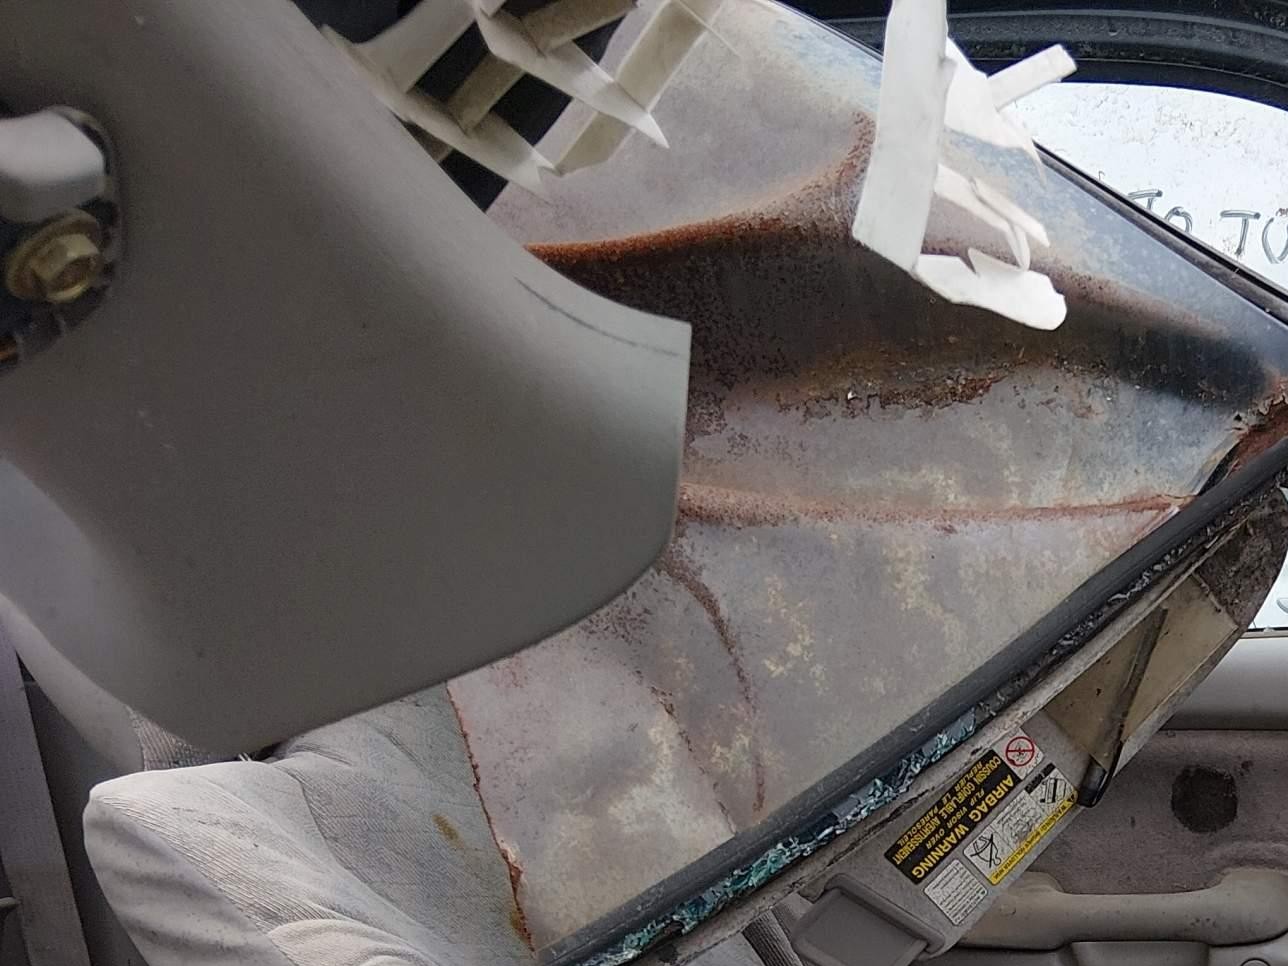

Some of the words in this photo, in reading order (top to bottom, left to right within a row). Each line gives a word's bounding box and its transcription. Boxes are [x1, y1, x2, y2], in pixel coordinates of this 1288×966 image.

[968, 774, 1014, 822] AIRBAG
[970, 788, 985, 806] FLIP
[946, 806, 968, 829] VISOR
[926, 828, 945, 849] OVER
[911, 823, 969, 878] WARNING
